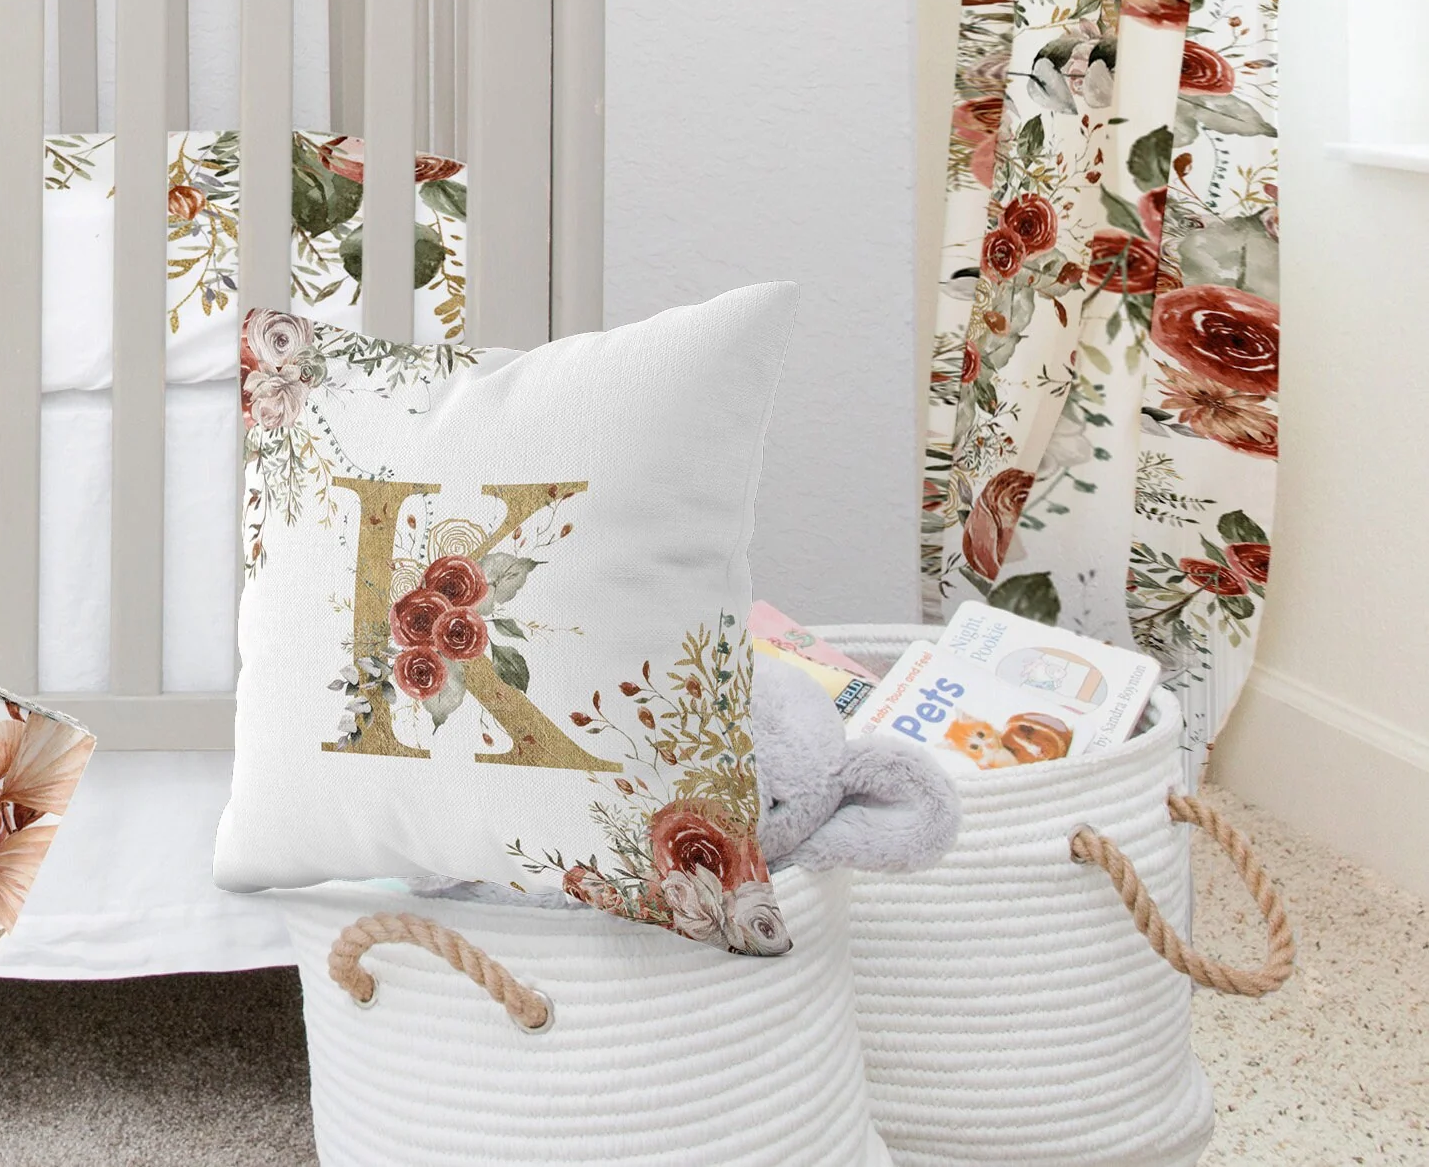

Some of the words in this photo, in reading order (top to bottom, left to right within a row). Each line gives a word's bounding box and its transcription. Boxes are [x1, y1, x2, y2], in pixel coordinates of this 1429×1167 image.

[321, 476, 623, 772] K
[970, 623, 1008, 662] Pookie
[870, 705, 893, 724] Baby
[885, 682, 909, 704] Touch
[905, 667, 921, 682] and
[915, 650, 933, 668] Feel
[1117, 665, 1146, 701] Boynton
[891, 677, 965, 743] Pets
[1100, 701, 1128, 734] Sandra
[1093, 735, 1112, 748] by
